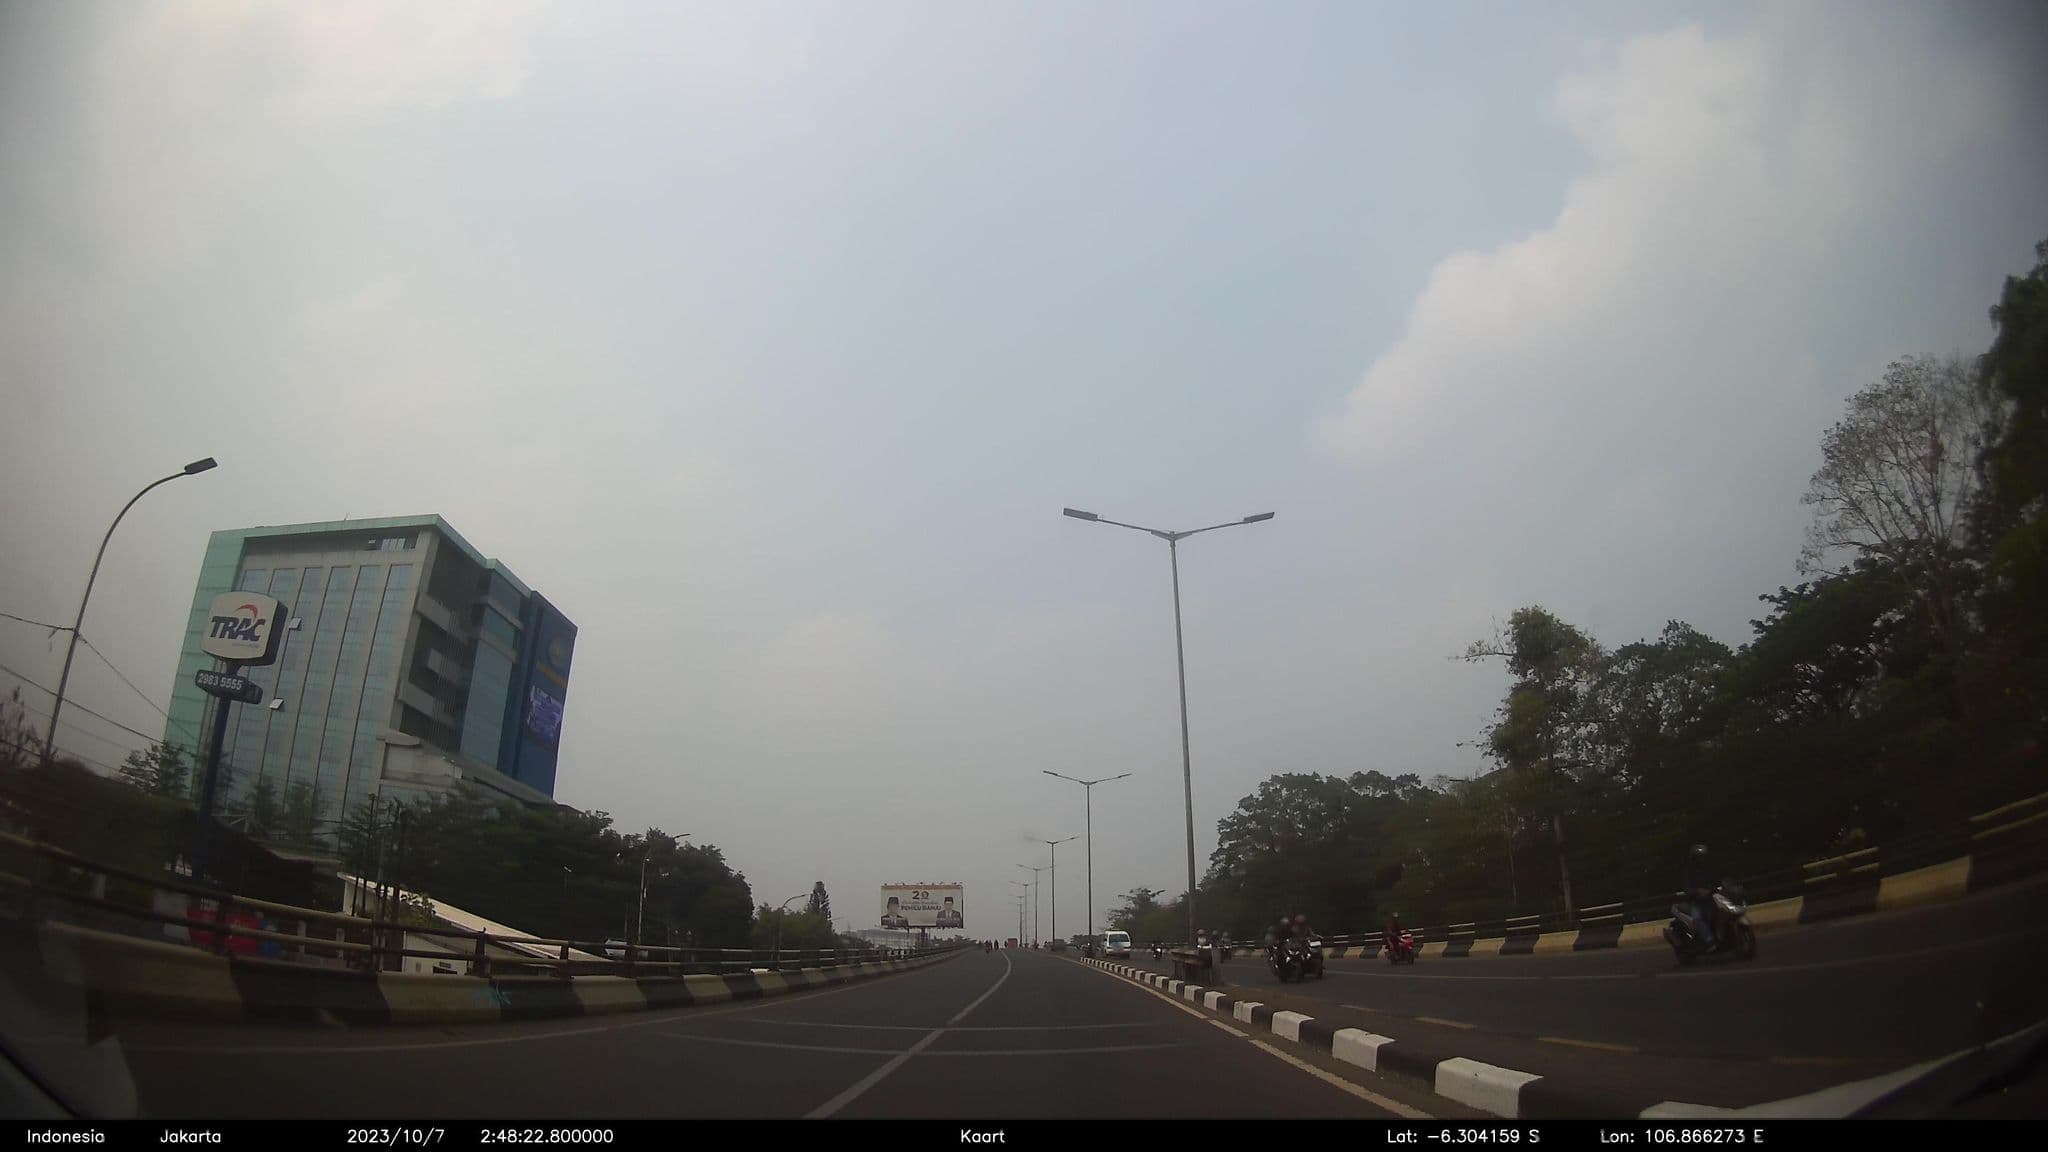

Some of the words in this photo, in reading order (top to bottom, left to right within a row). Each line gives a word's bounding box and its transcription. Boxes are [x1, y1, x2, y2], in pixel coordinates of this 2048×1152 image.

[210, 616, 266, 642] TRAC
[197, 673, 219, 686] 2983
[220, 678, 244, 690] 5555
